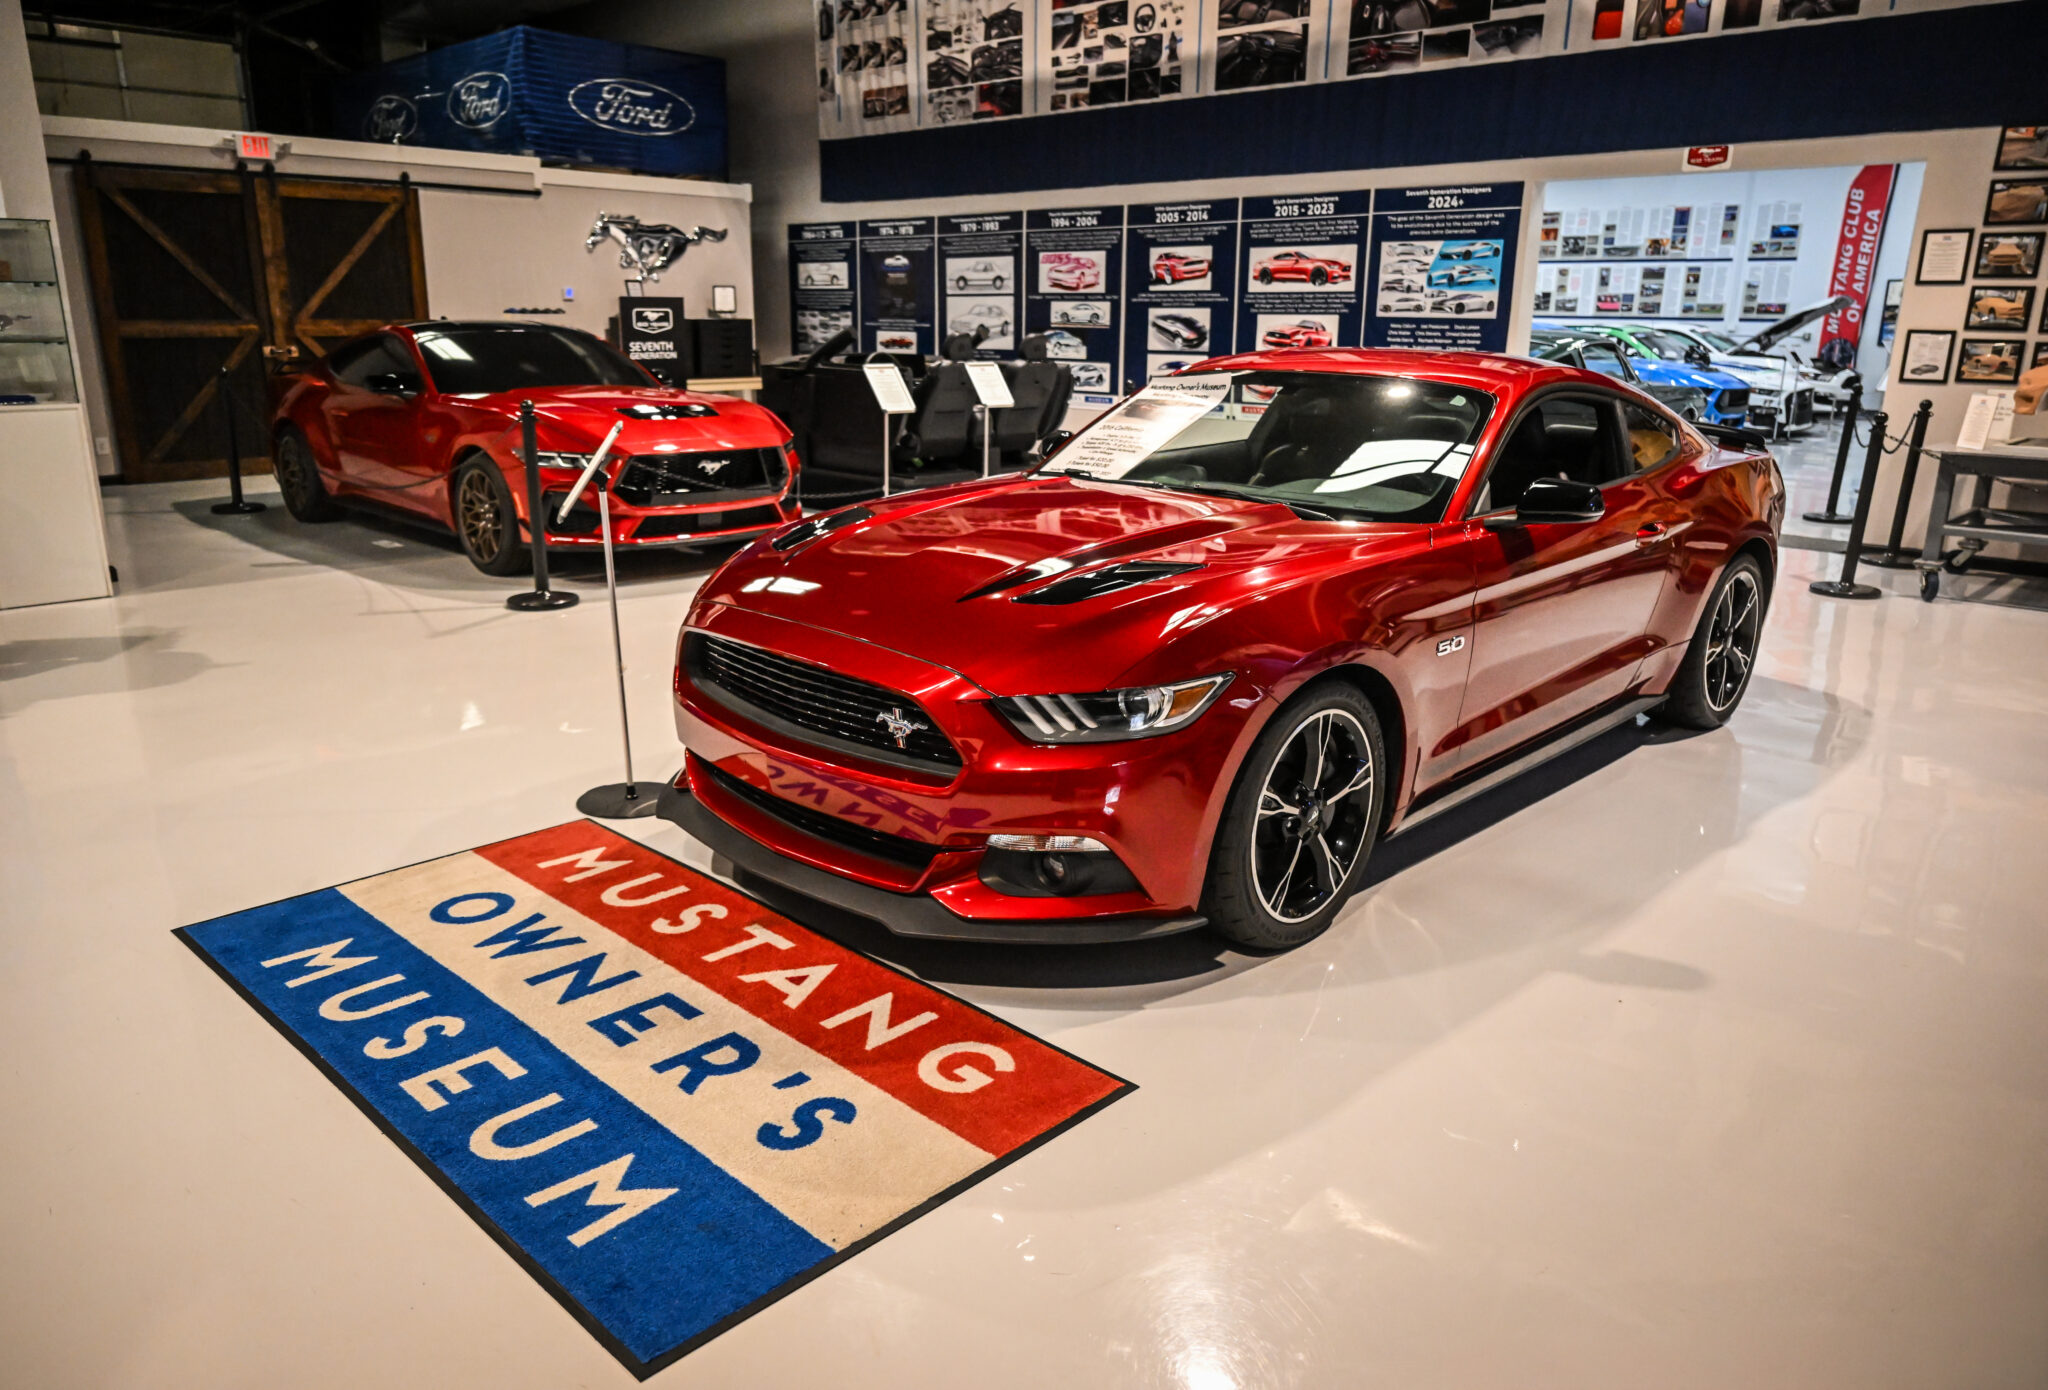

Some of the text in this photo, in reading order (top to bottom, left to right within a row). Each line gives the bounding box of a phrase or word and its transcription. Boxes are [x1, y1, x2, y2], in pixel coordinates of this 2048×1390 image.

[460, 80, 502, 121] Ford
[595, 83, 672, 129] Ford
[1430, 188, 1461, 196] Generation
[1428, 196, 1464, 209] 2024+
[1155, 212, 1180, 223] 2005
[1186, 210, 1209, 222] 2014
[1274, 205, 1300, 217] 2015
[1307, 203, 1335, 215] 2023
[1844, 188, 1865, 238] CLUB
[1050, 217, 1070, 228] 1994
[1076, 216, 1098, 227] 2004
[1853, 209, 1881, 294] AMERICA
[628, 341, 674, 352] SEVENTH
[629, 351, 678, 360] GENERATION
[1200, 383, 1227, 391] Museum
[537, 846, 1016, 1094] MUSTANG
[429, 891, 857, 1151] OWNER'S
[260, 938, 679, 1248] MUSEUM
